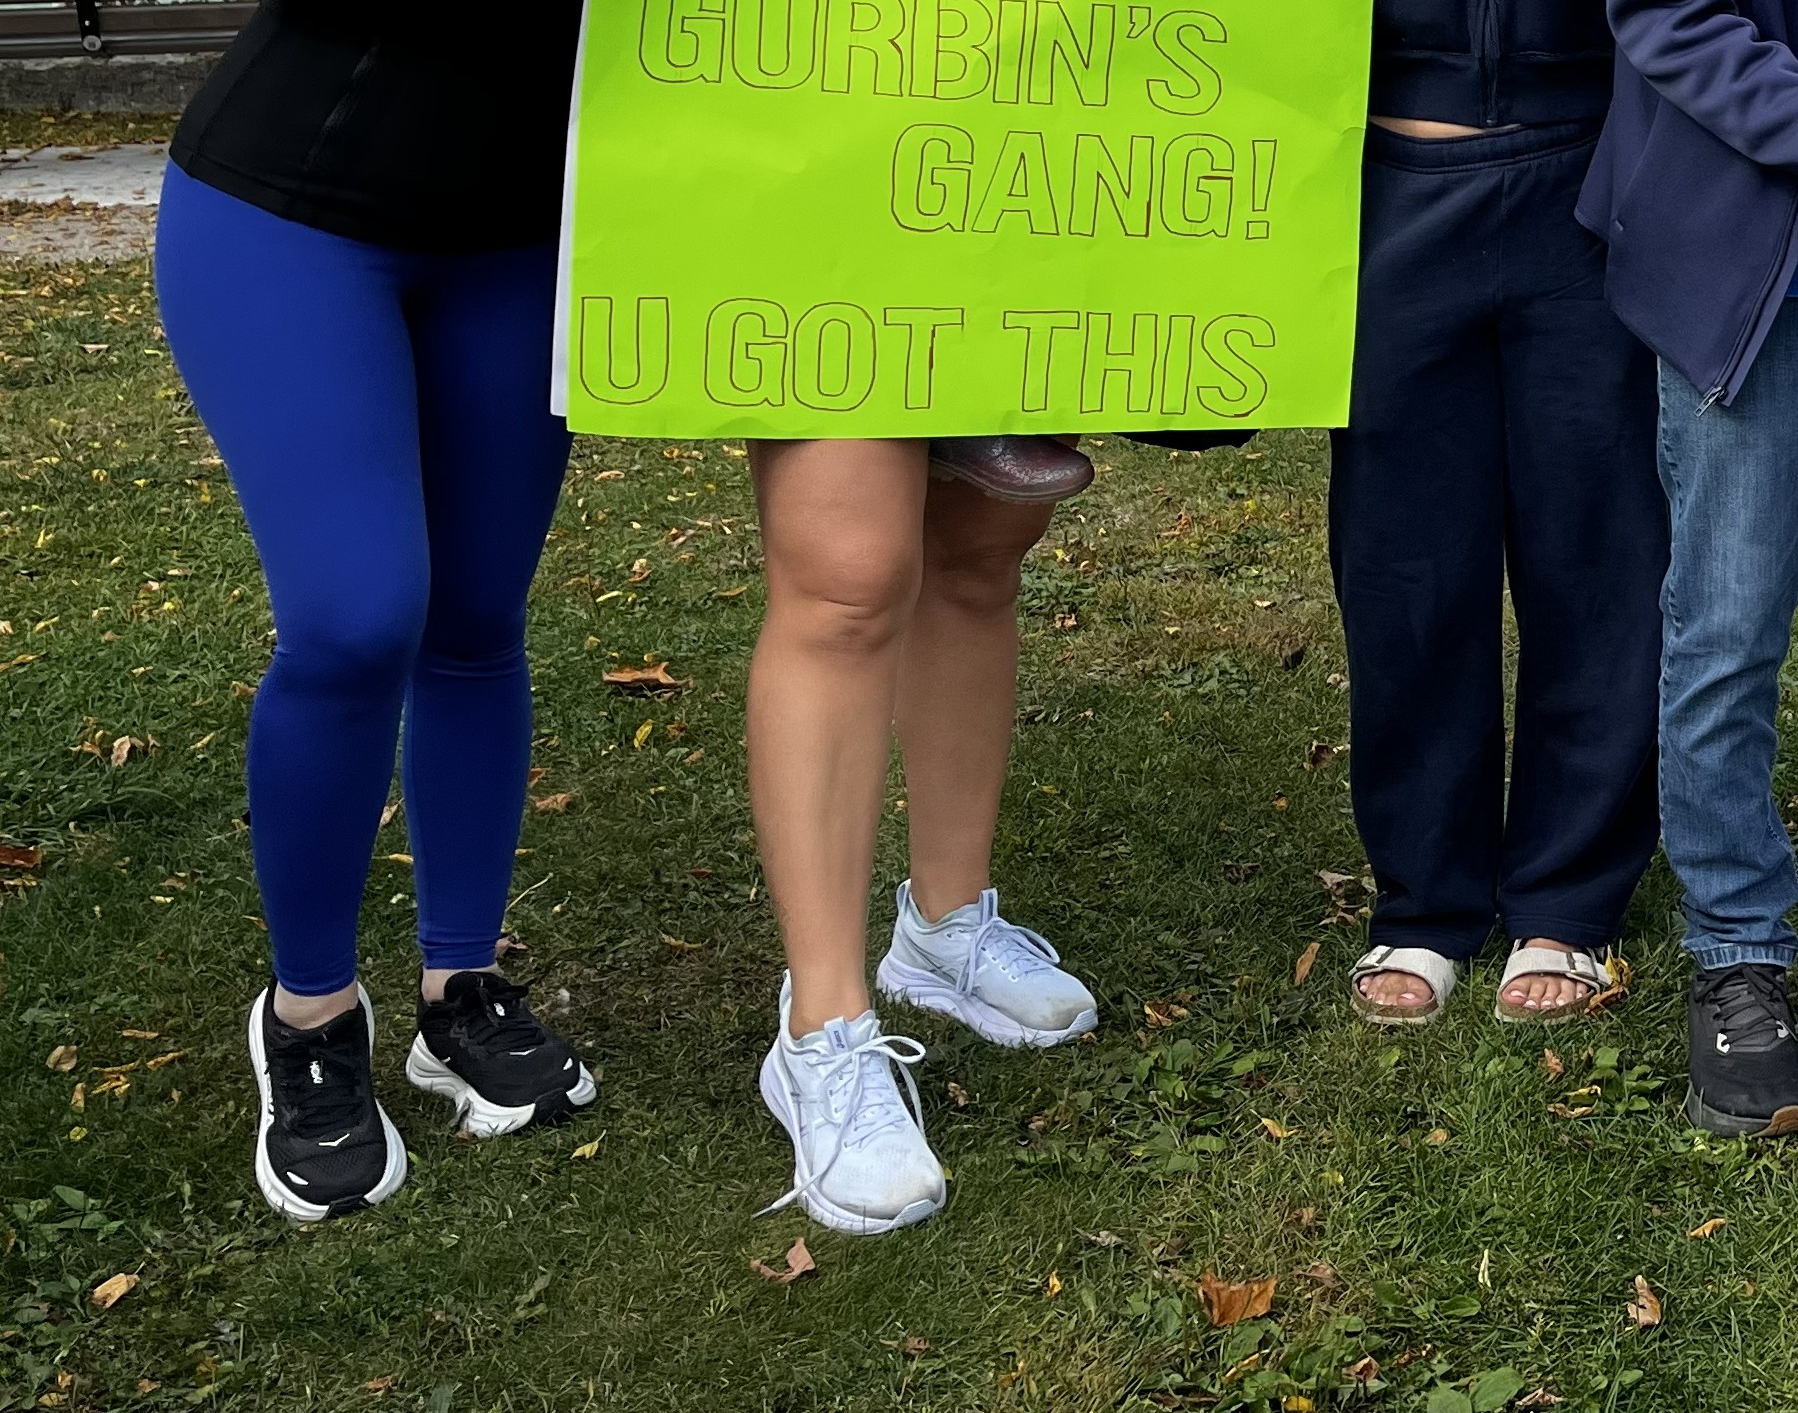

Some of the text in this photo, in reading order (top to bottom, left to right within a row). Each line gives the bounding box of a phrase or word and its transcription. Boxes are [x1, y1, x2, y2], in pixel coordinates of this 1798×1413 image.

[890, 123, 1278, 241] GANG!
[579, 296, 1276, 418] U GOT THIS
